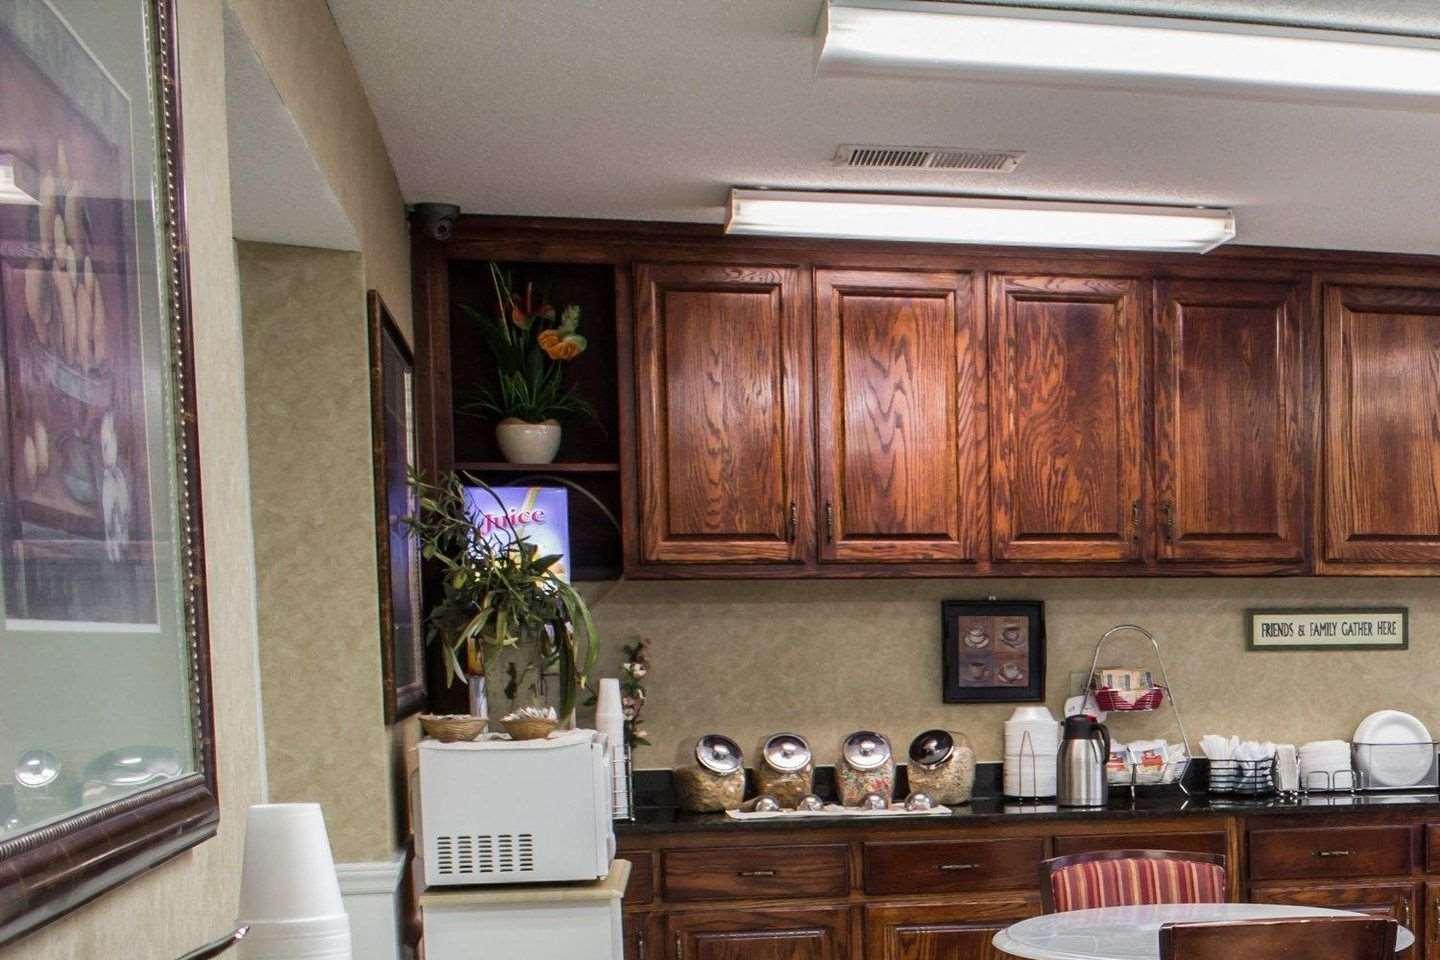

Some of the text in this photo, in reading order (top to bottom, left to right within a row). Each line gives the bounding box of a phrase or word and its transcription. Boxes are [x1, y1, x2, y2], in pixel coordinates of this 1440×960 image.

[1261, 620, 1397, 638] FRIENDS & FAMILY GATHER HERE
